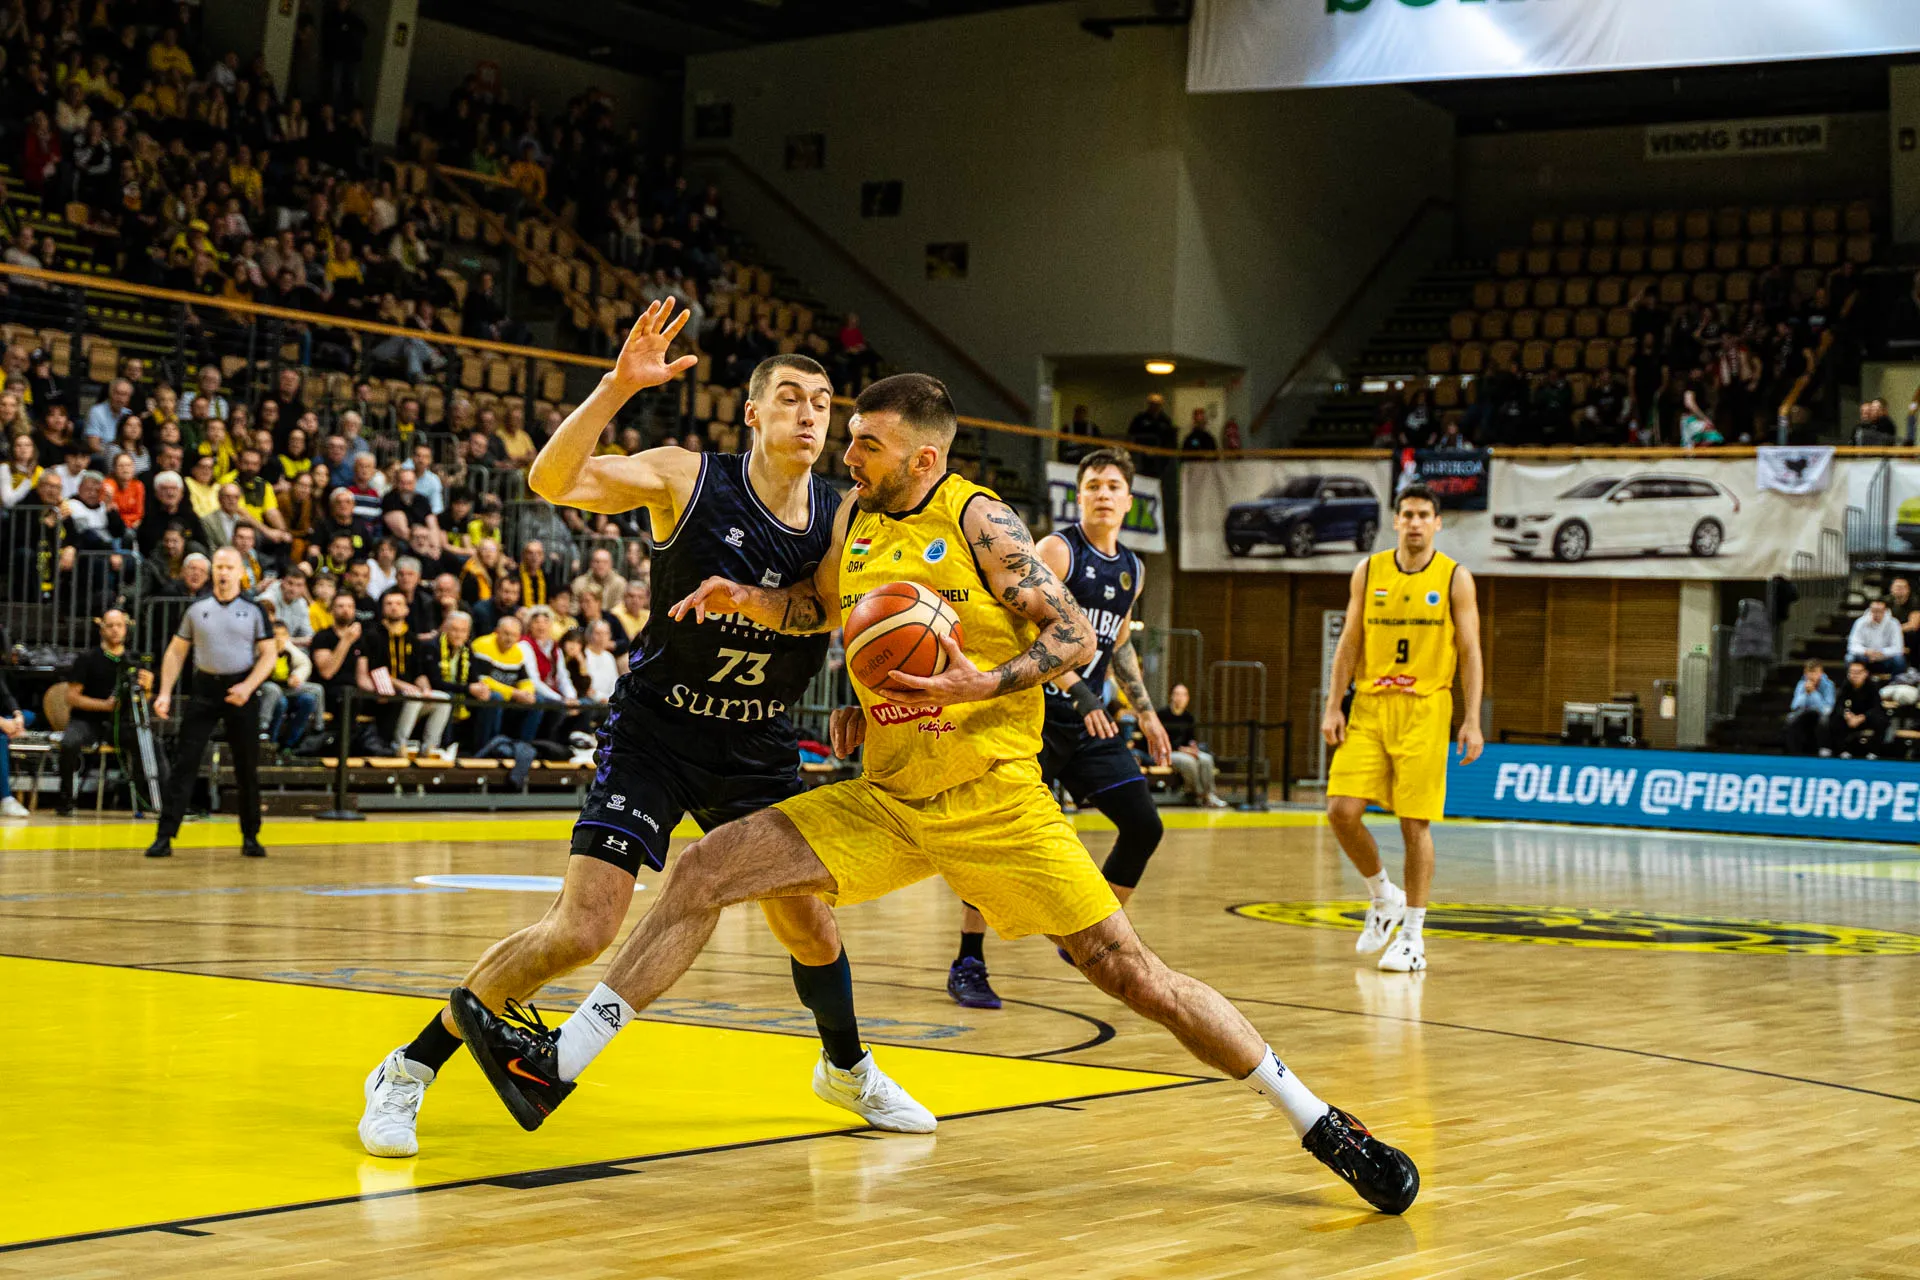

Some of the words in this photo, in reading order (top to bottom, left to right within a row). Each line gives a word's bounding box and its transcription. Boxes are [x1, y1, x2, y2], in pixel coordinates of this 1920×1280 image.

[936, 588, 969, 602] HELY
[859, 648, 894, 677] molten
[1395, 639, 1409, 664] 9
[707, 647, 772, 686] 73
[1493, 762, 1638, 806] FOLLOW
[1640, 768, 1920, 823] @FIBAEUROPE
[632, 808, 643, 819] EL
[591, 1002, 623, 1032] PEAK
